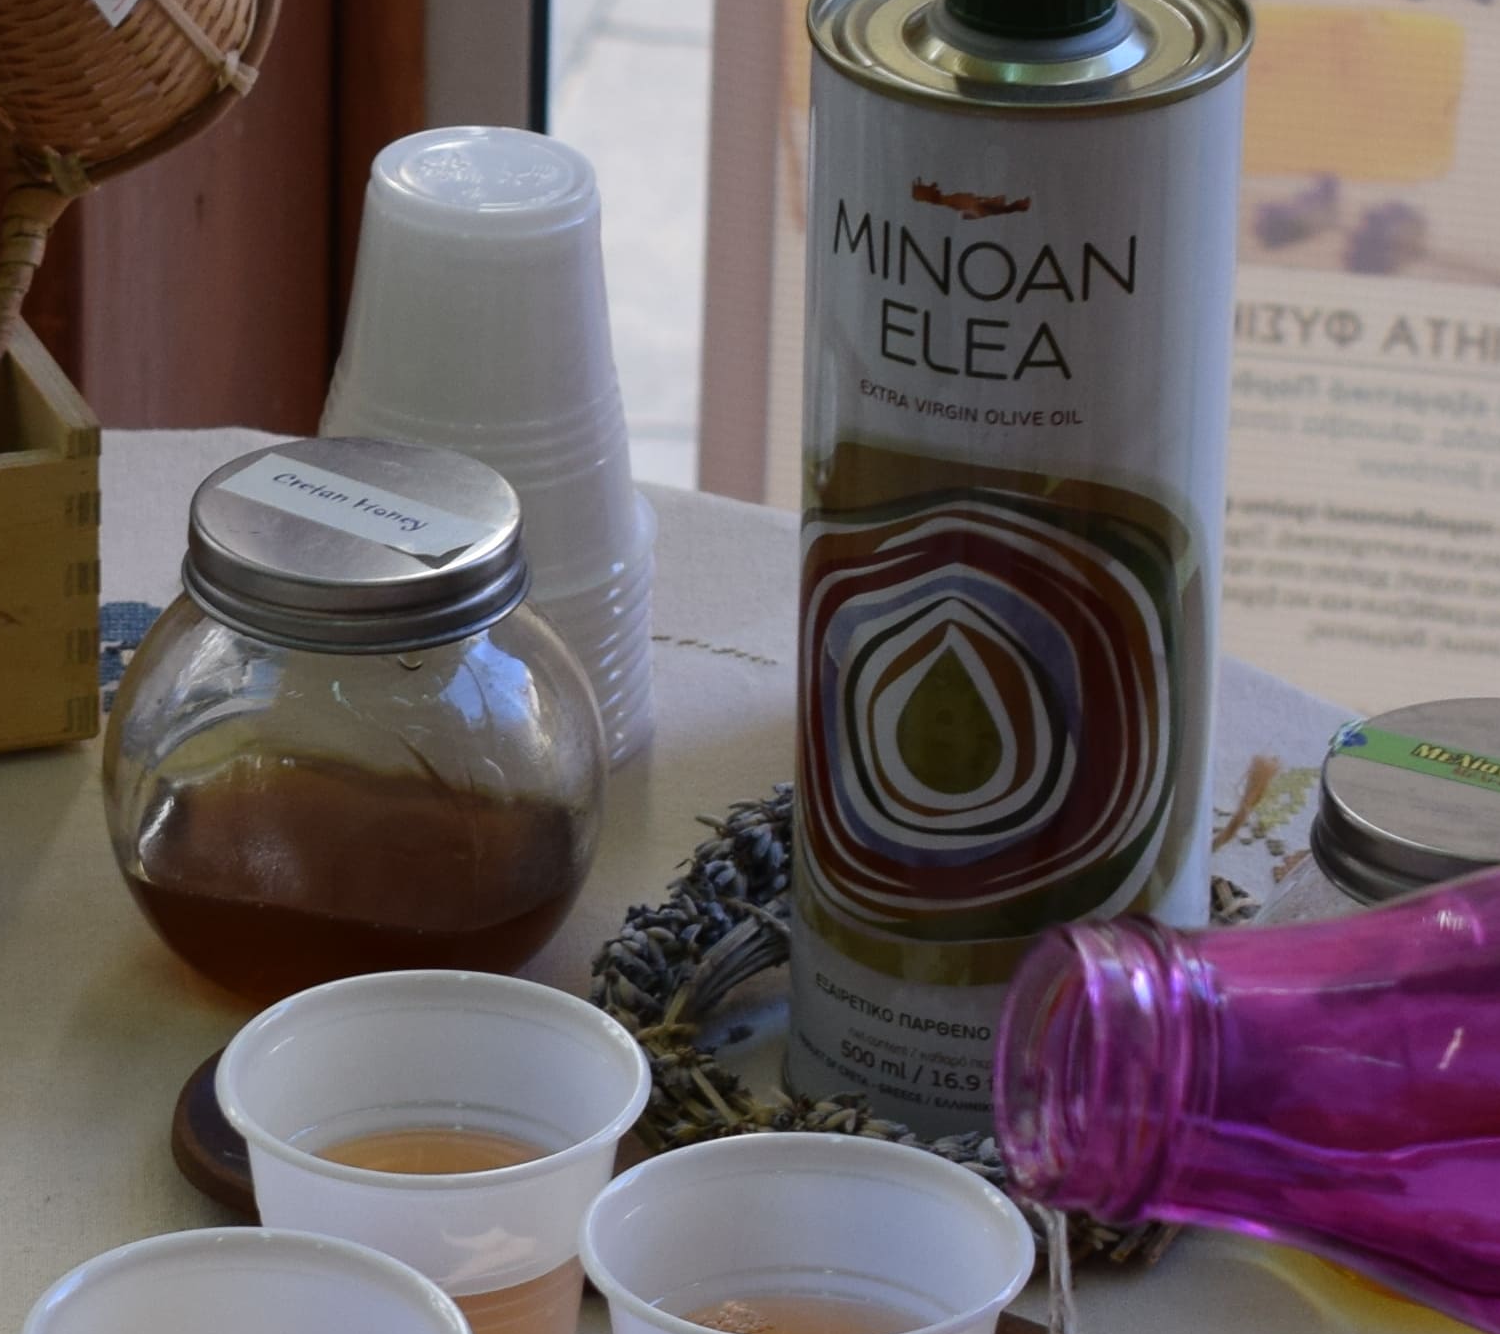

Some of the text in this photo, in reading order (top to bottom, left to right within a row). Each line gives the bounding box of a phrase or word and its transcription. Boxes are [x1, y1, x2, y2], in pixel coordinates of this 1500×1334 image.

[834, 198, 1137, 303] MINOAN
[881, 297, 1072, 381] ELEA
[860, 378, 1083, 427] EXTRA VIRGIN OLIVE OIL
[271, 472, 428, 533] Cretan Honey
[899, 1012, 992, 1041] ΠΑΡΘΕΝΟ
[841, 1038, 876, 1069] 500
[881, 1059, 906, 1081] ml
[932, 1069, 981, 1092] 16.9
